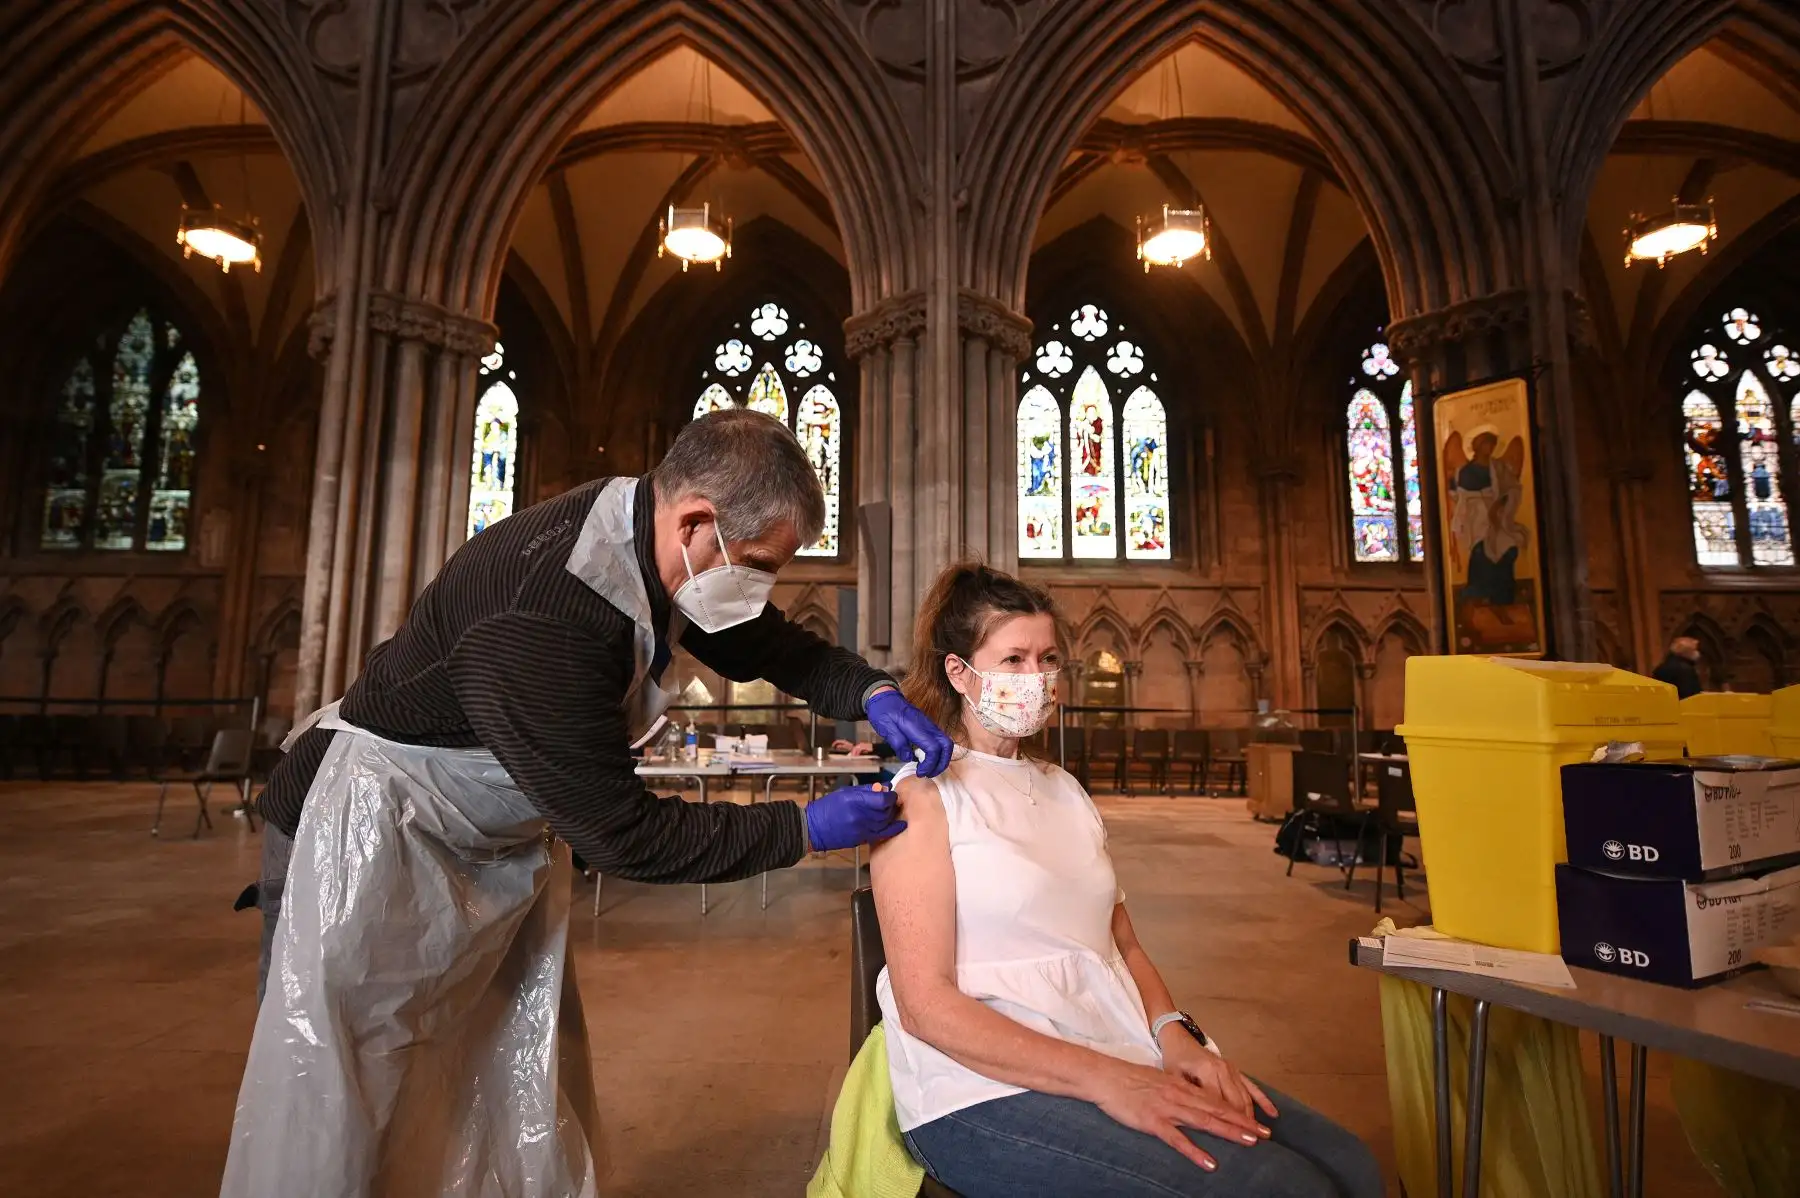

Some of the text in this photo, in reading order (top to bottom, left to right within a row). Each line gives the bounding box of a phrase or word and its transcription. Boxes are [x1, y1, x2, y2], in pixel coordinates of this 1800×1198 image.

[1628, 844, 1660, 862] BD
[1728, 843, 1742, 860] 200
[1618, 947, 1650, 967] BD
[1727, 949, 1742, 965] 200
